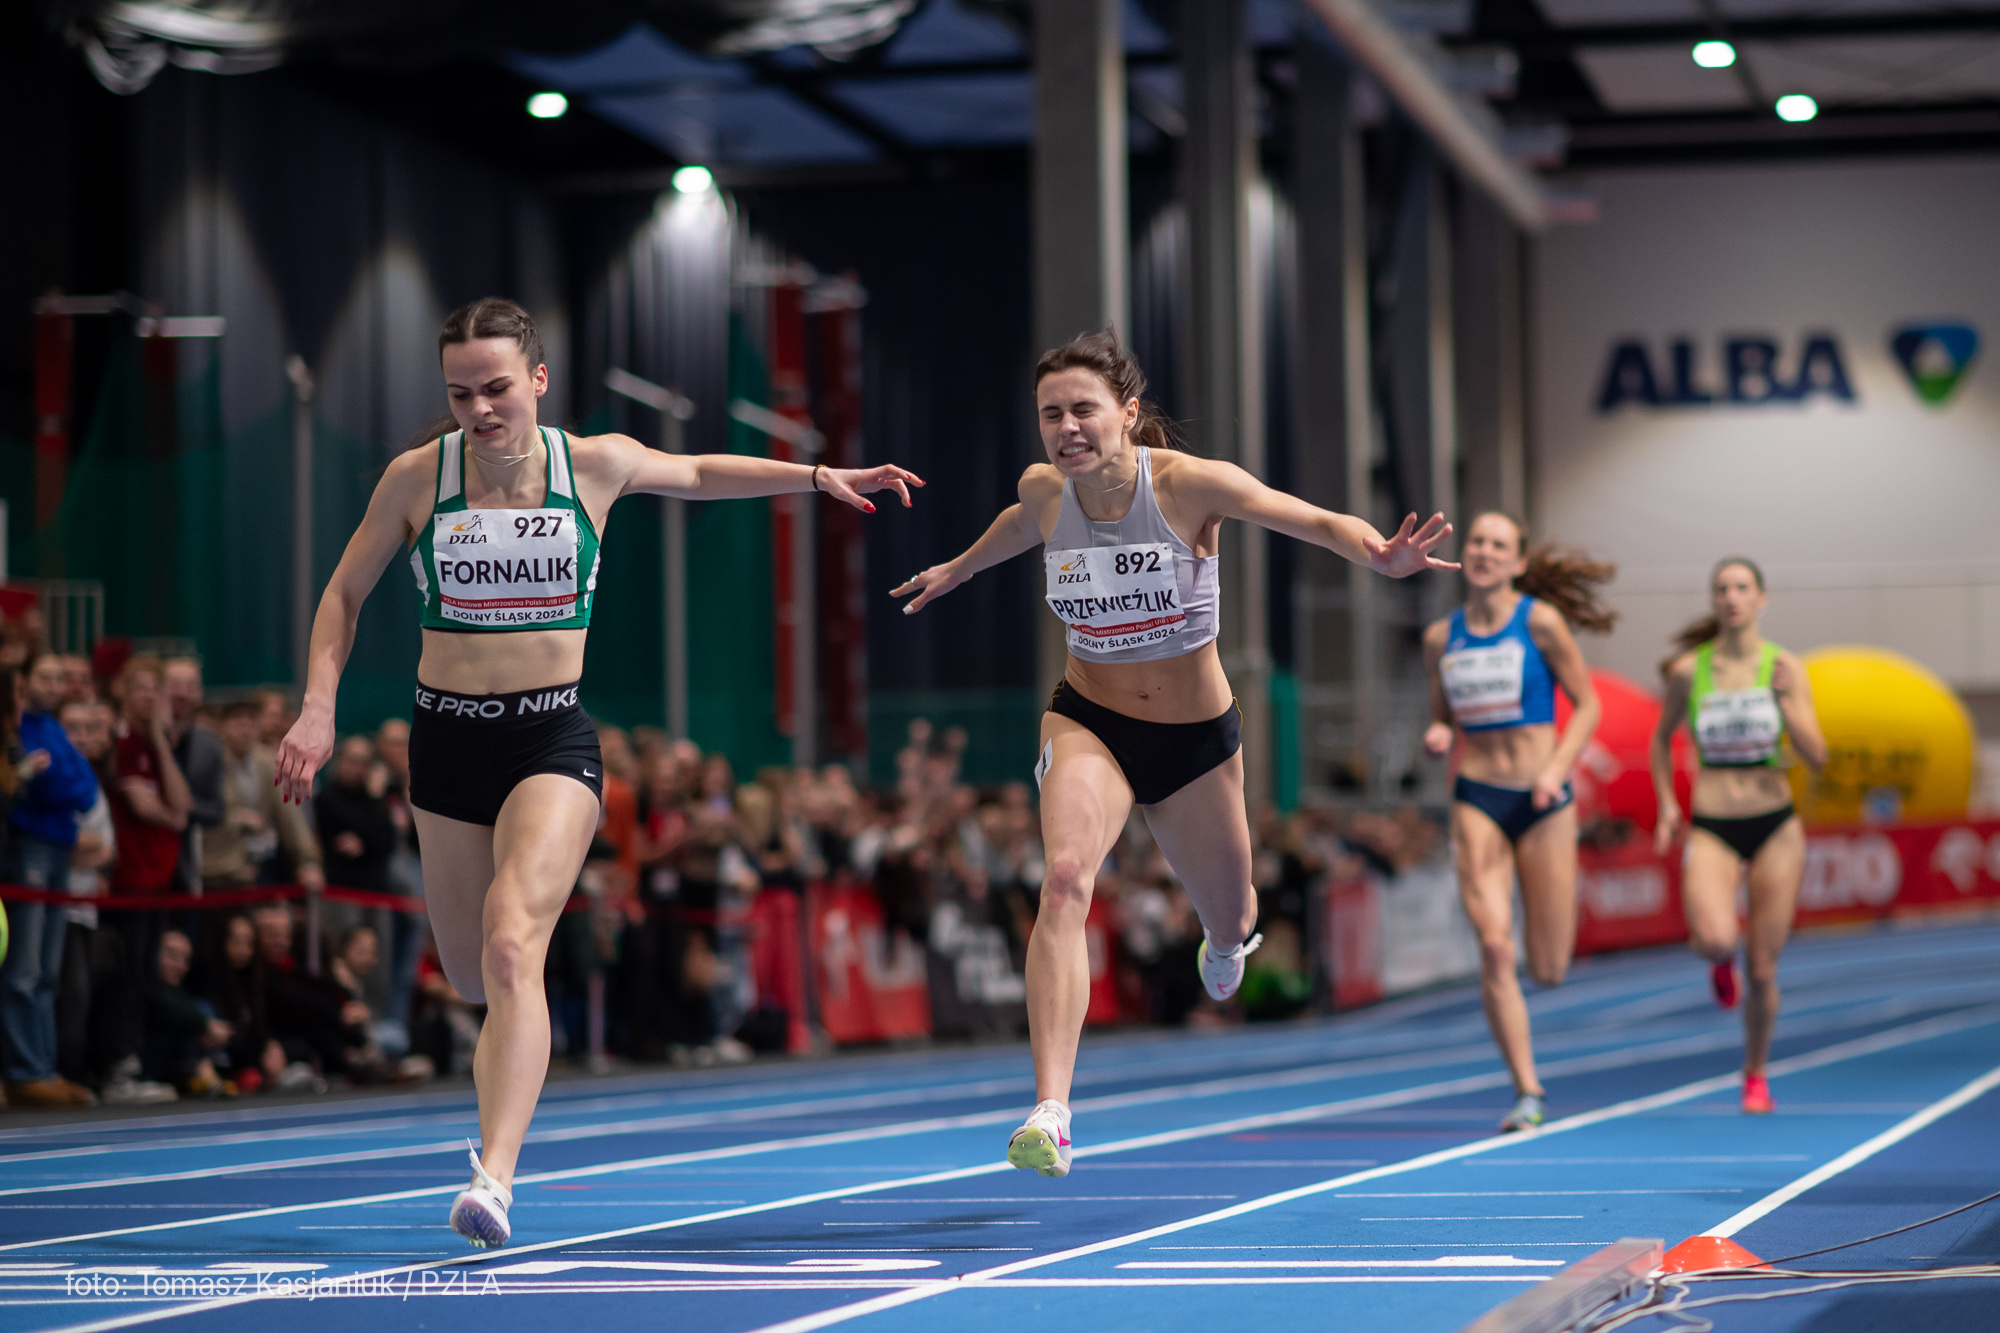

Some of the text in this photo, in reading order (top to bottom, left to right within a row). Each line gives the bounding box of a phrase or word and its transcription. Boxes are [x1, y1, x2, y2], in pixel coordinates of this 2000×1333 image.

[1595, 335, 1857, 408] ALBA
[514, 516, 563, 538] 927
[449, 534, 487, 544] DZLA
[440, 557, 573, 585] FORNALIK
[1115, 551, 1161, 575] 892
[1058, 573, 1091, 584] DZLA
[443, 597, 457, 605] PZLA
[457, 600, 482, 608] Halowe
[484, 599, 524, 608] Mistrzostwa
[525, 598, 545, 606] Polski
[562, 596, 574, 604] U20
[1052, 588, 1177, 619] PRZEWIEŹLIK
[453, 609, 564, 623] DOLNY ŚLĄSK 2024
[1096, 625, 1135, 636] Mistrzostwa
[1136, 621, 1154, 630] Polski
[1108, 635, 1145, 647] ŚLĄSK
[1147, 627, 1176, 641] 2024
[437, 696, 505, 719] PRO
[517, 686, 578, 715] NIKE
